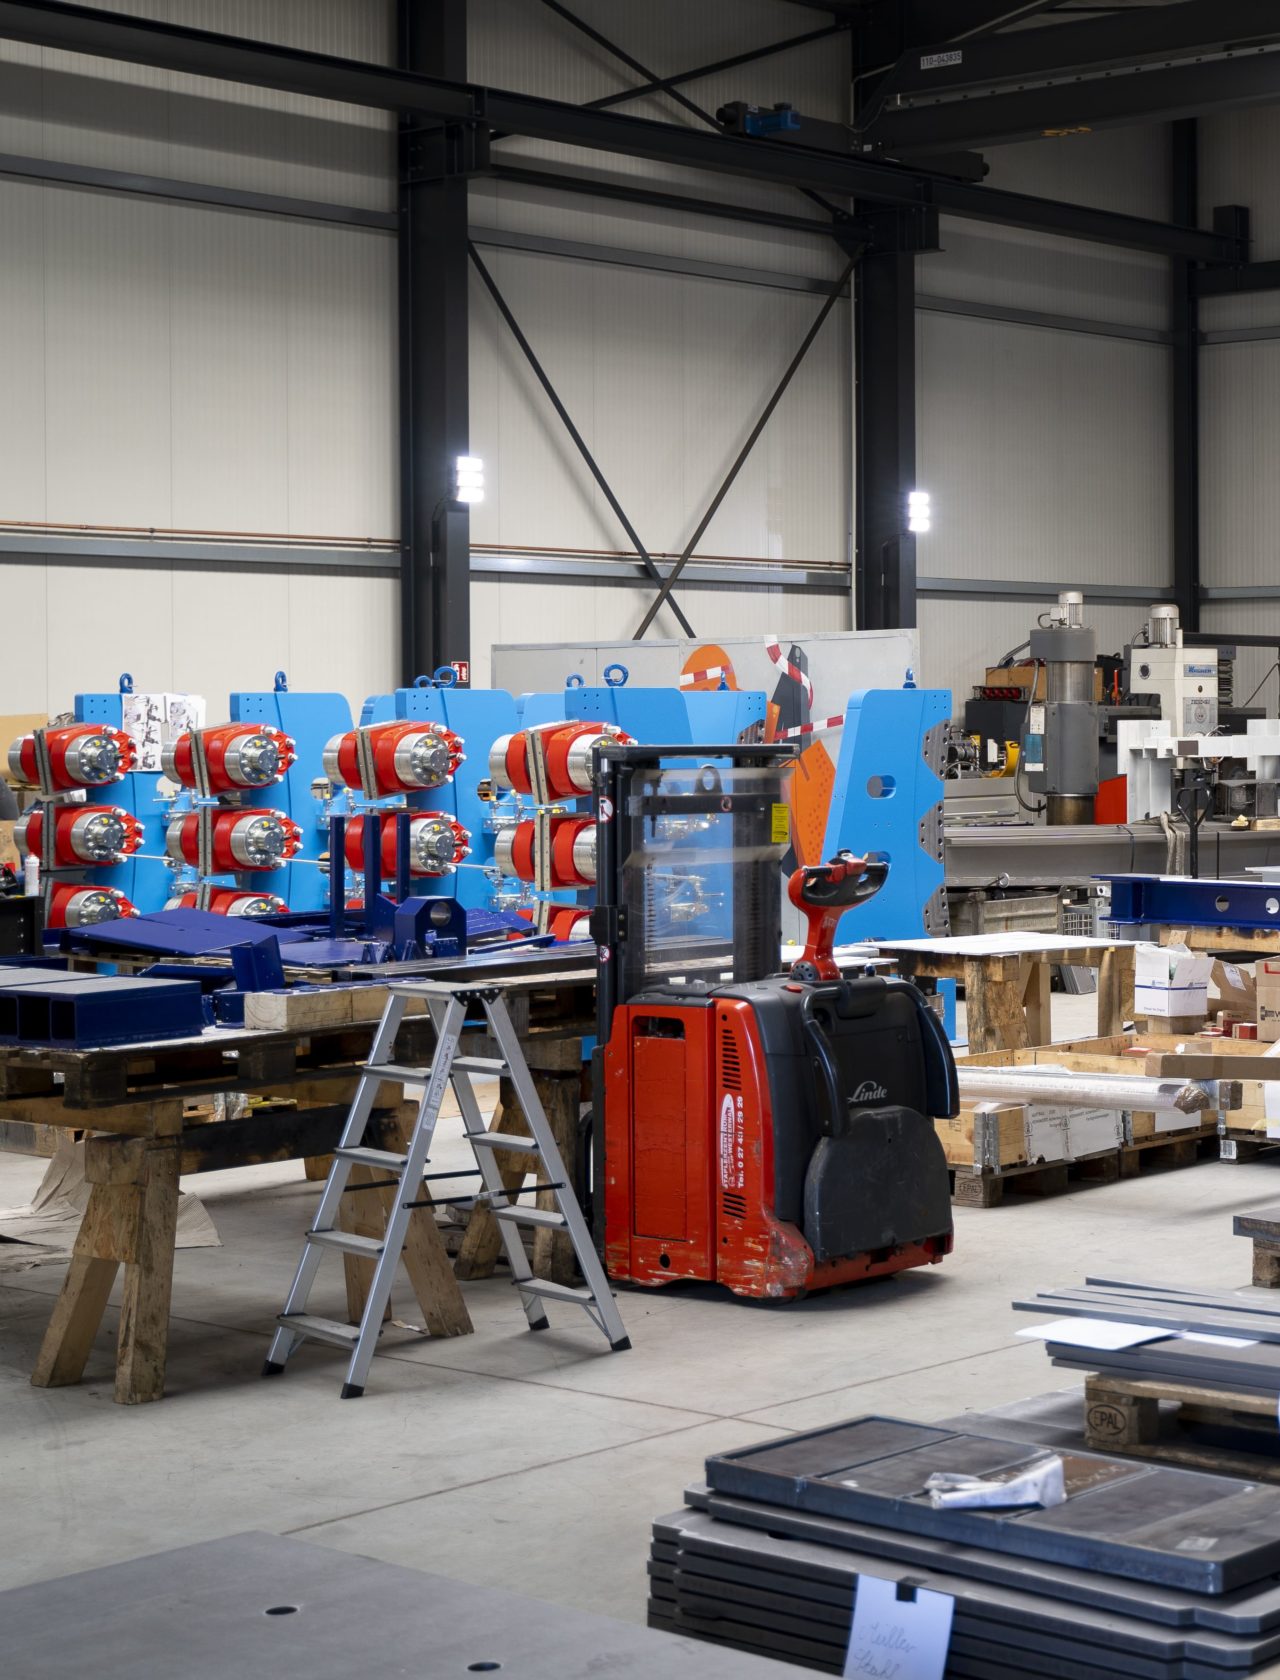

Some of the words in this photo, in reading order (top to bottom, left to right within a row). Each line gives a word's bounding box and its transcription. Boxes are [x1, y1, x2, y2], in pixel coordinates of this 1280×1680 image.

[848, 1081, 887, 1102] Linde
[738, 1147, 744, 1159] 27
[1094, 1410, 1121, 1429] EPAL
